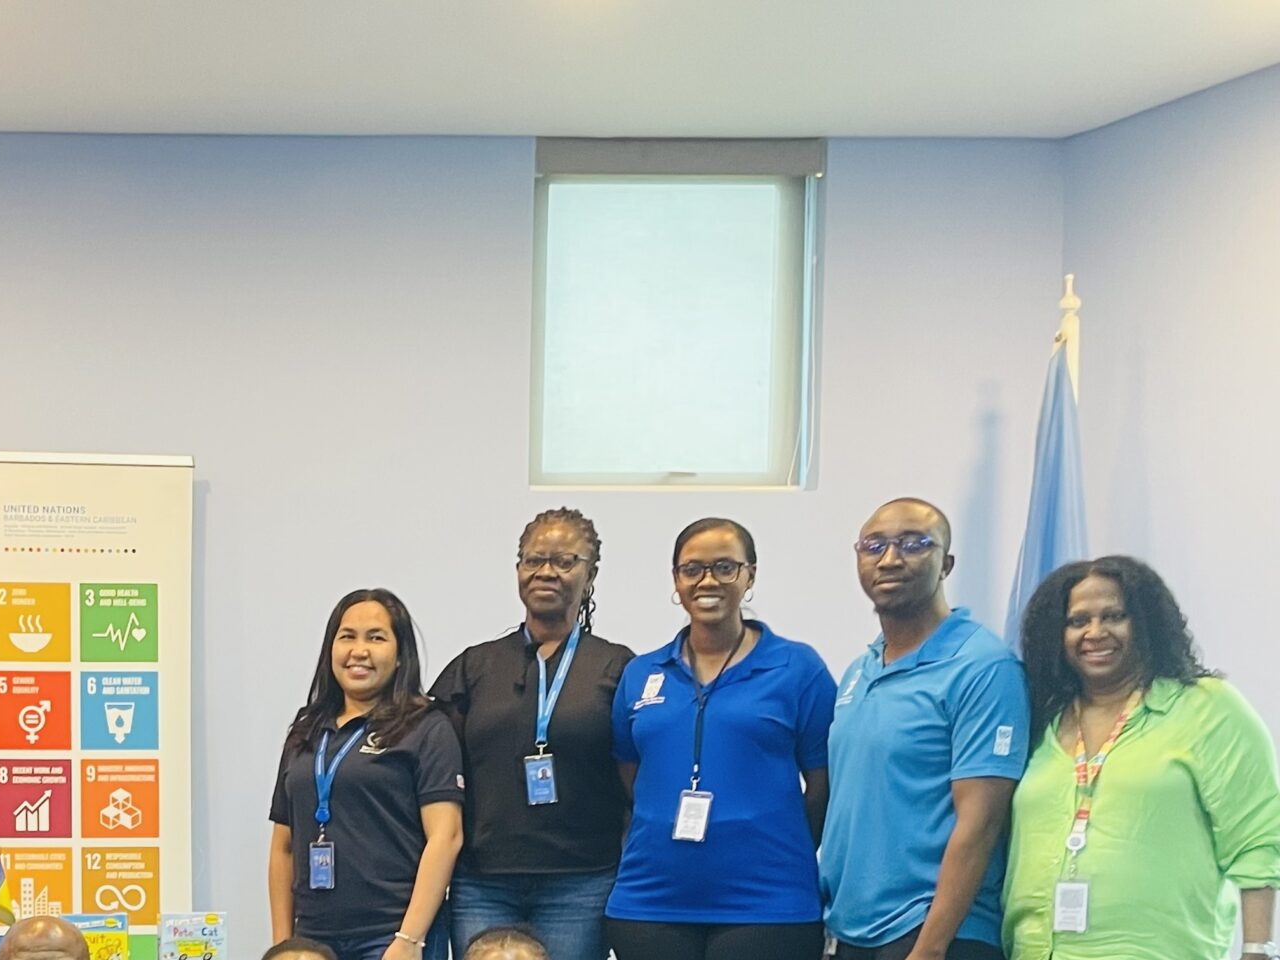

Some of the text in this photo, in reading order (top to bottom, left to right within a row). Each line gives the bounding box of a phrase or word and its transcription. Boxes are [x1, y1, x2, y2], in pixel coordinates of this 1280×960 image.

[3, 504, 86, 515] UNITED NATIONS
[85, 589, 95, 606] 3
[87, 677, 96, 695] 6
[0, 766, 8, 784] 8
[86, 765, 96, 782] 9
[85, 853, 101, 870] 12
[201, 927, 218, 936] Cat
